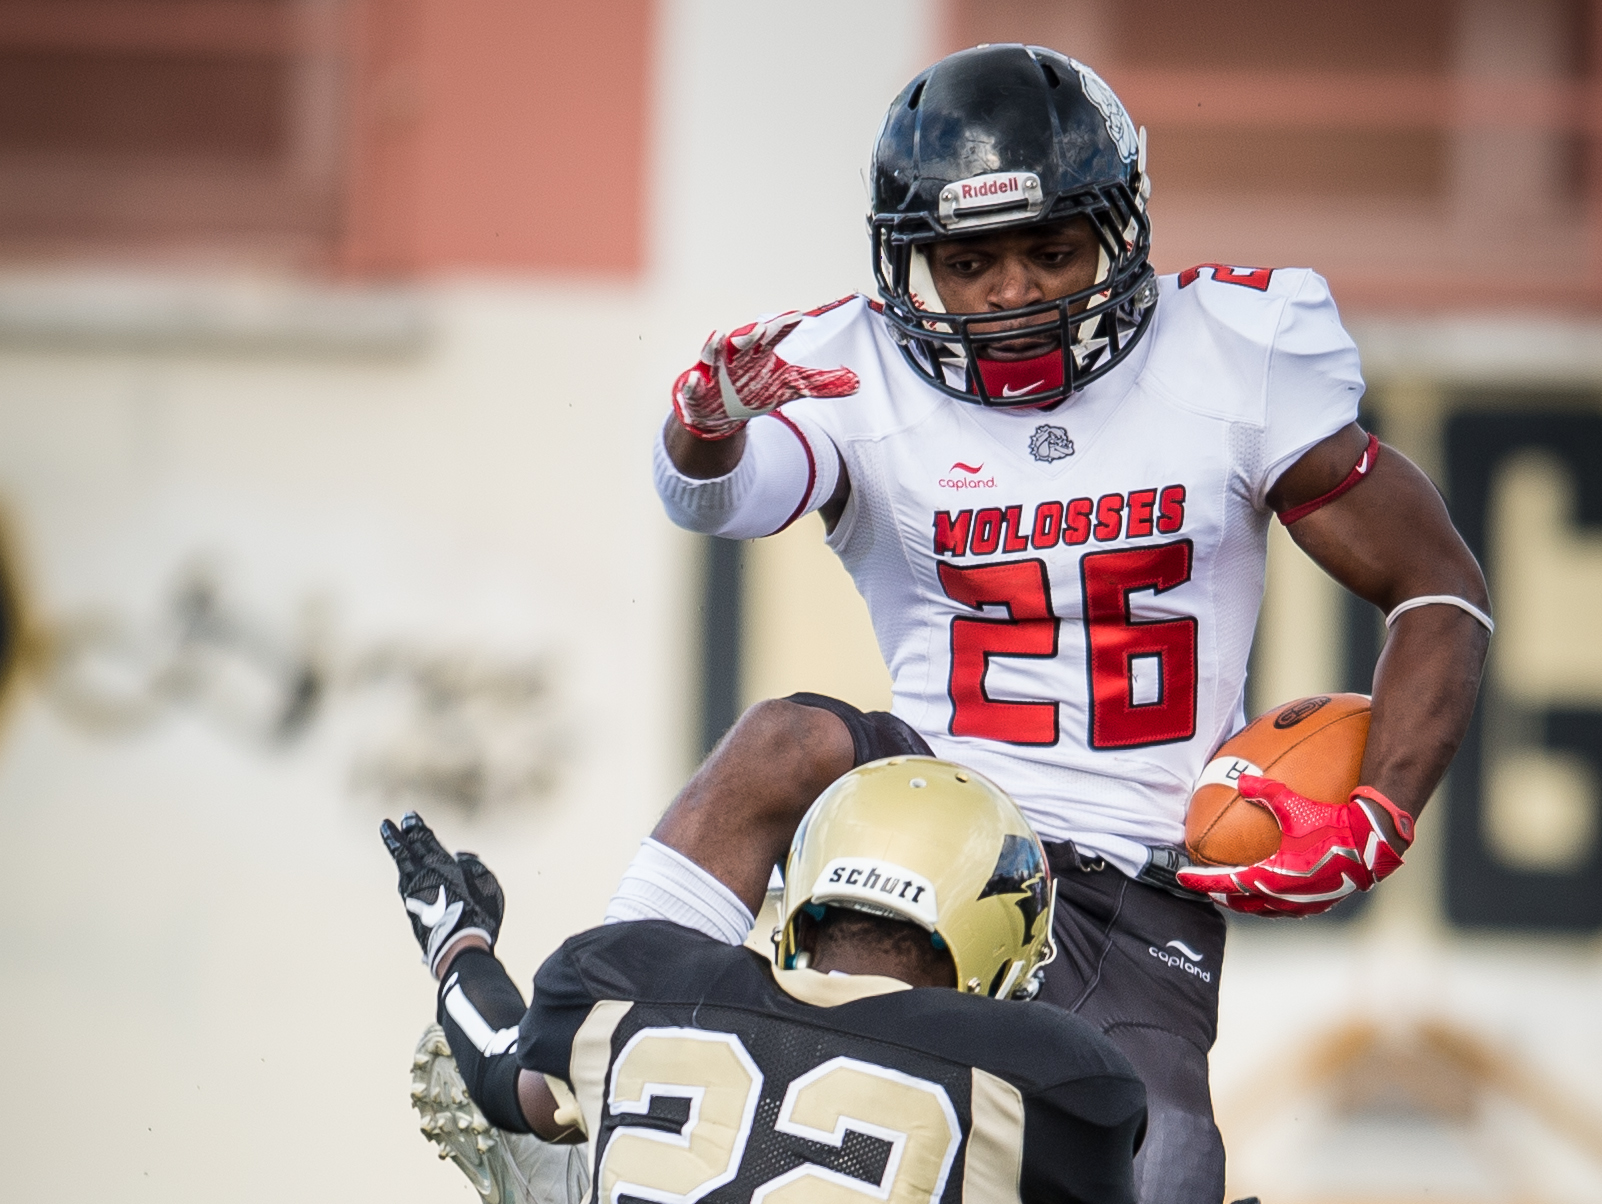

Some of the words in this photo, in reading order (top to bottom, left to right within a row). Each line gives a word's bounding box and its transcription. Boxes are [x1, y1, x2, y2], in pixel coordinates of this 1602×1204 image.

[961, 176, 1019, 200] Riddell
[938, 475, 998, 492] capland
[932, 483, 1187, 557] MOLOSSES
[936, 537, 1199, 752] 26
[828, 866, 926, 904] schutt
[1148, 945, 1212, 983] capland
